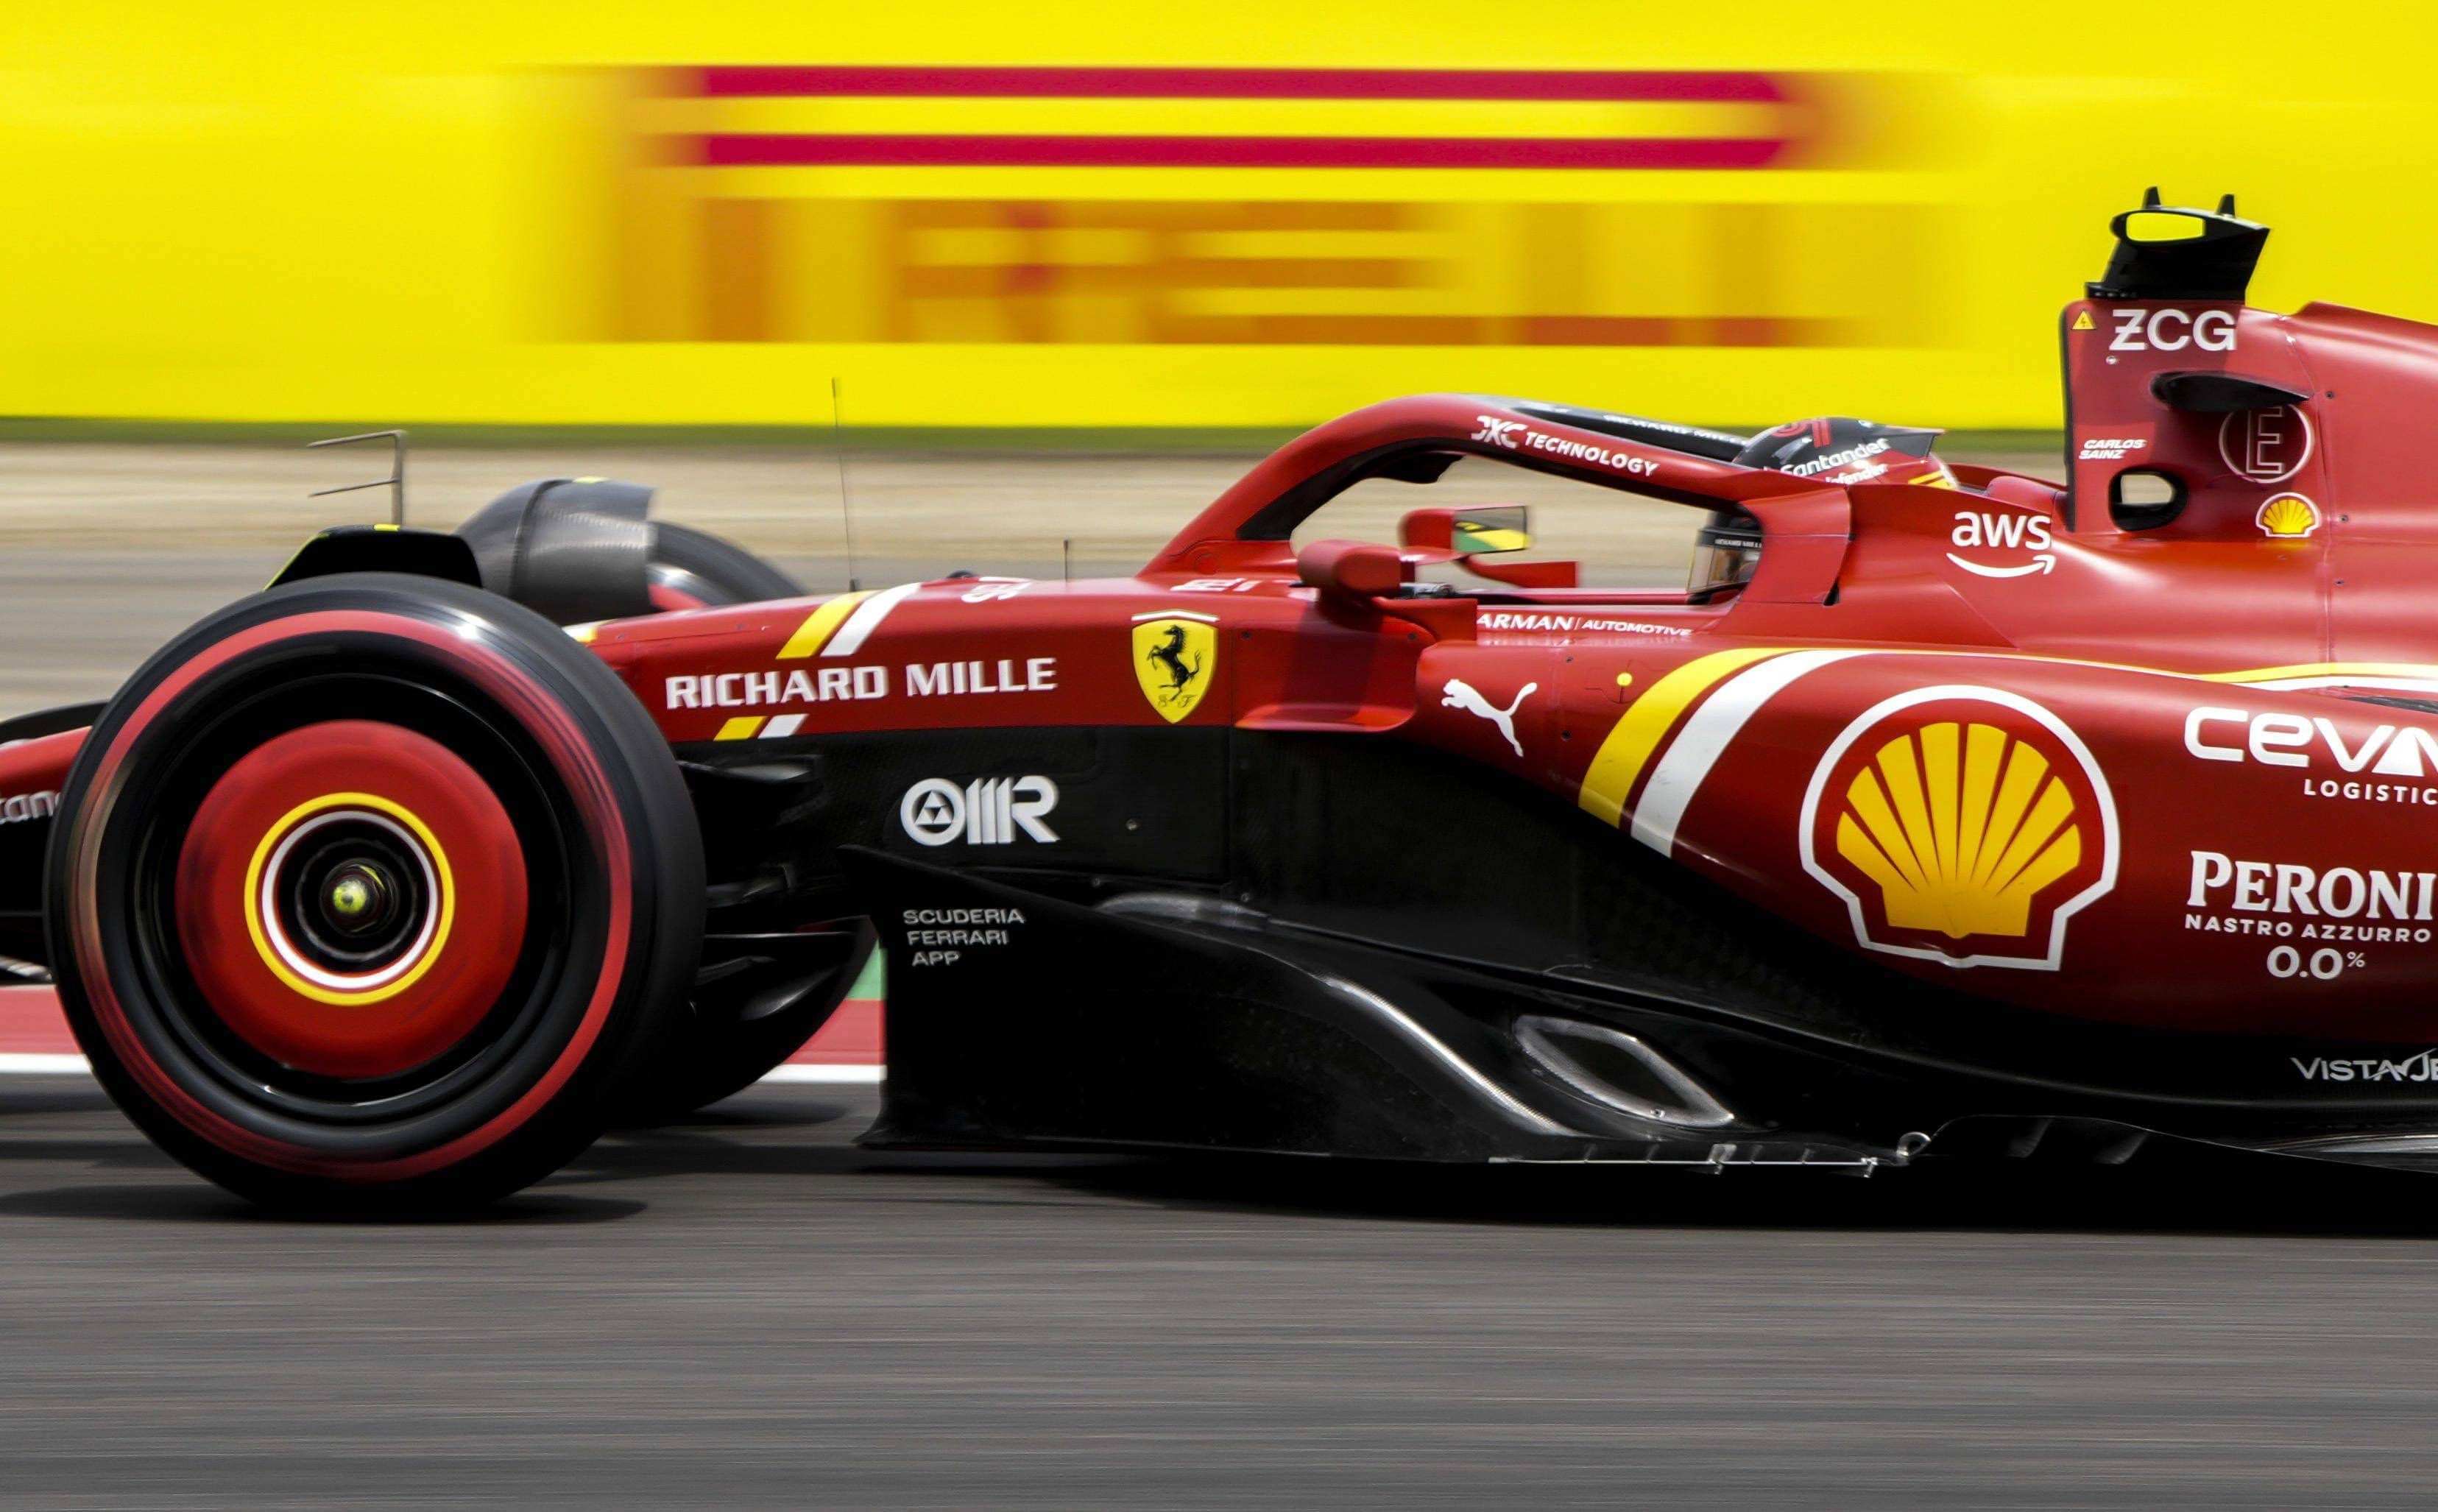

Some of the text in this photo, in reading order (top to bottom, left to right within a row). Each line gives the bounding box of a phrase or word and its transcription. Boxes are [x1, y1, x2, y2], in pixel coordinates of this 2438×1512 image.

[1524, 431, 1660, 477] TECHNOLOGY
[2078, 449, 2125, 460] SAINZ
[2083, 439, 2148, 449] CARLOS
[1951, 511, 2052, 551] aws
[1477, 613, 1692, 638] ARMAN AUTOMOTIVE
[665, 657, 1056, 709] RICHARD MILLE
[2186, 850, 2437, 921] PERONI
[903, 908, 1025, 925] SCUDERIA
[2185, 914, 2431, 943] NASTRO AZZURRO
[907, 930, 1008, 945] FERRARI
[912, 950, 959, 967] APP
[2266, 945, 2365, 980] 0.0%
